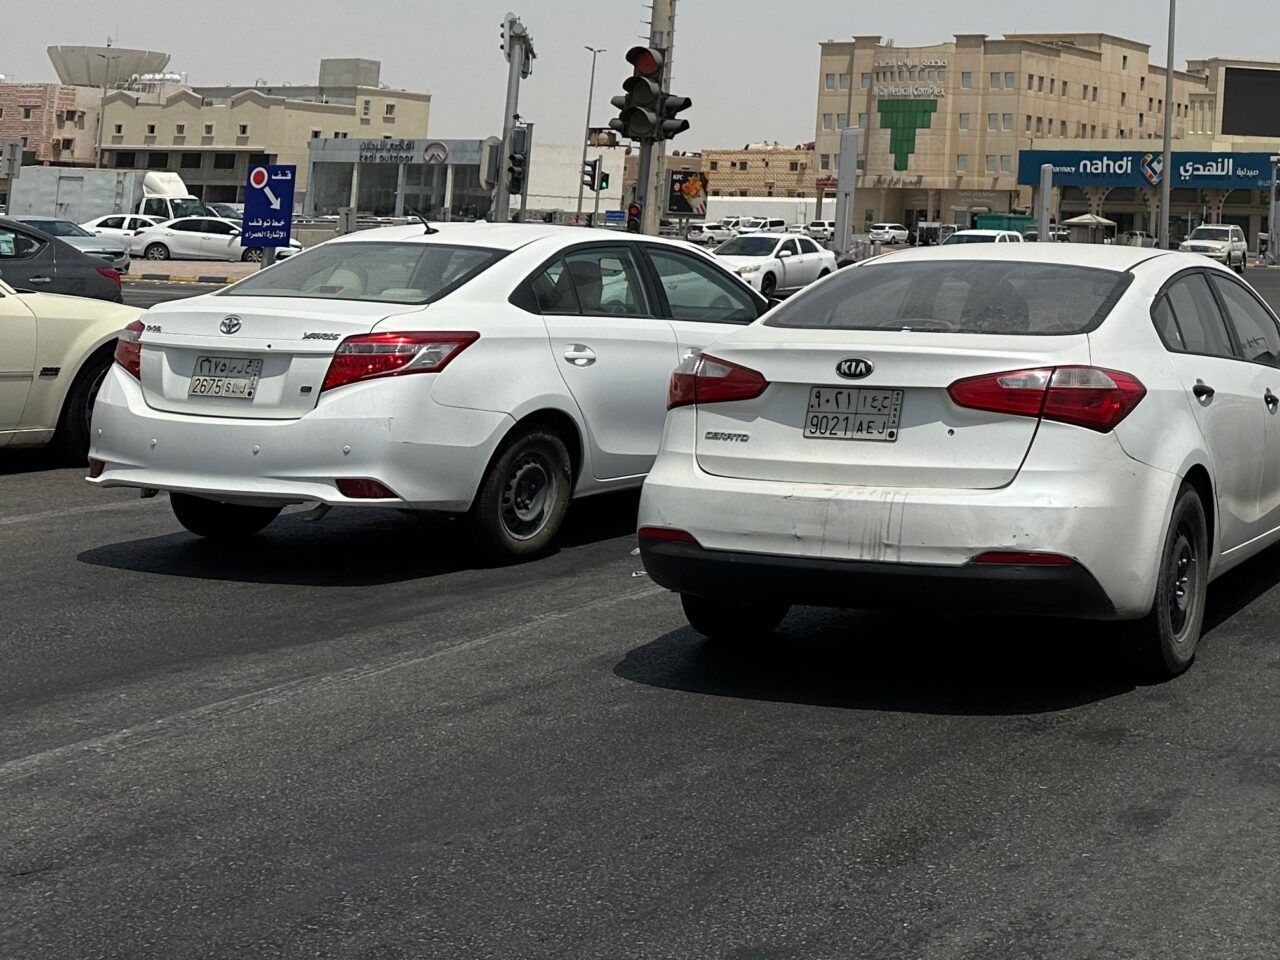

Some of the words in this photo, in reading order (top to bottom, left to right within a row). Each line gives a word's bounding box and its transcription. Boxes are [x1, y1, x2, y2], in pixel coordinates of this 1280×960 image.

[1079, 156, 1132, 174] nahdi
[1180, 158, 1234, 180] النهدي
[271, 170, 292, 180] قف
[248, 218, 271, 228] توقف
[271, 219, 286, 227] خط
[245, 230, 267, 239] الحمراء
[841, 361, 869, 375] KIA
[192, 378, 223, 394] 2675
[809, 415, 850, 436] 9021
[856, 420, 886, 434] AEJ
